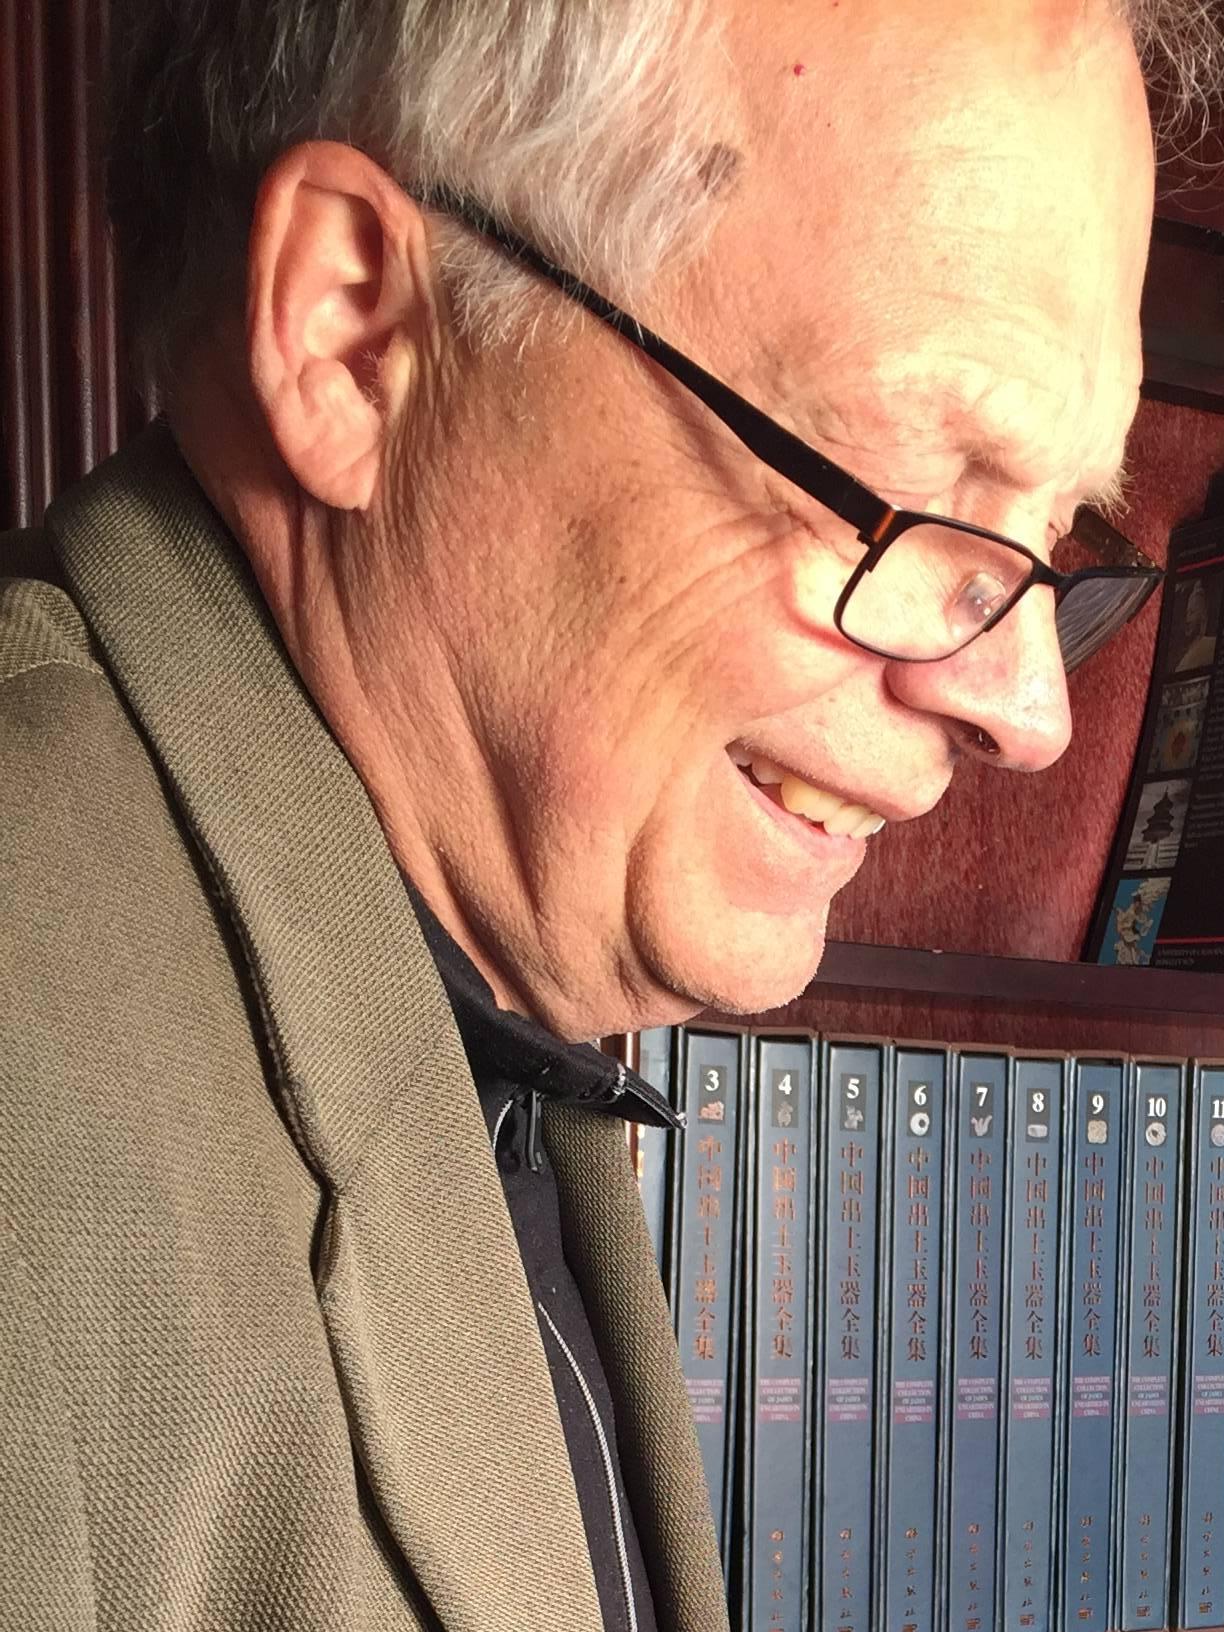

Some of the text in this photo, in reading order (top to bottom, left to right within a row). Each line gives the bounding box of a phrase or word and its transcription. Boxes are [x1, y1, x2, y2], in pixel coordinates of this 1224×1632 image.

[705, 1070, 720, 1091] 3
[778, 1074, 792, 1095] 4
[846, 1079, 860, 1099] 5
[913, 1085, 927, 1105] 6
[976, 1086, 988, 1107] 7
[1032, 1092, 1044, 1112] 8
[1092, 1094, 1104, 1114] 9
[1148, 1097, 1167, 1117] 10
[696, 1135, 723, 1360] 中国出土玉器全集
[772, 1135, 797, 1359] 中国出土玉器全集
[840, 1141, 864, 1359] 中国出土玉器全集
[907, 1146, 930, 1361] 中国出土玉器全集
[969, 1147, 993, 1361] 中国出土玉器全集
[1025, 1152, 1048, 1360] 中国出土玉器全集
[1082, 1152, 1105, 1357] 中国出土玉器全集
[1142, 1156, 1165, 1358] 中国出土玉器全集
